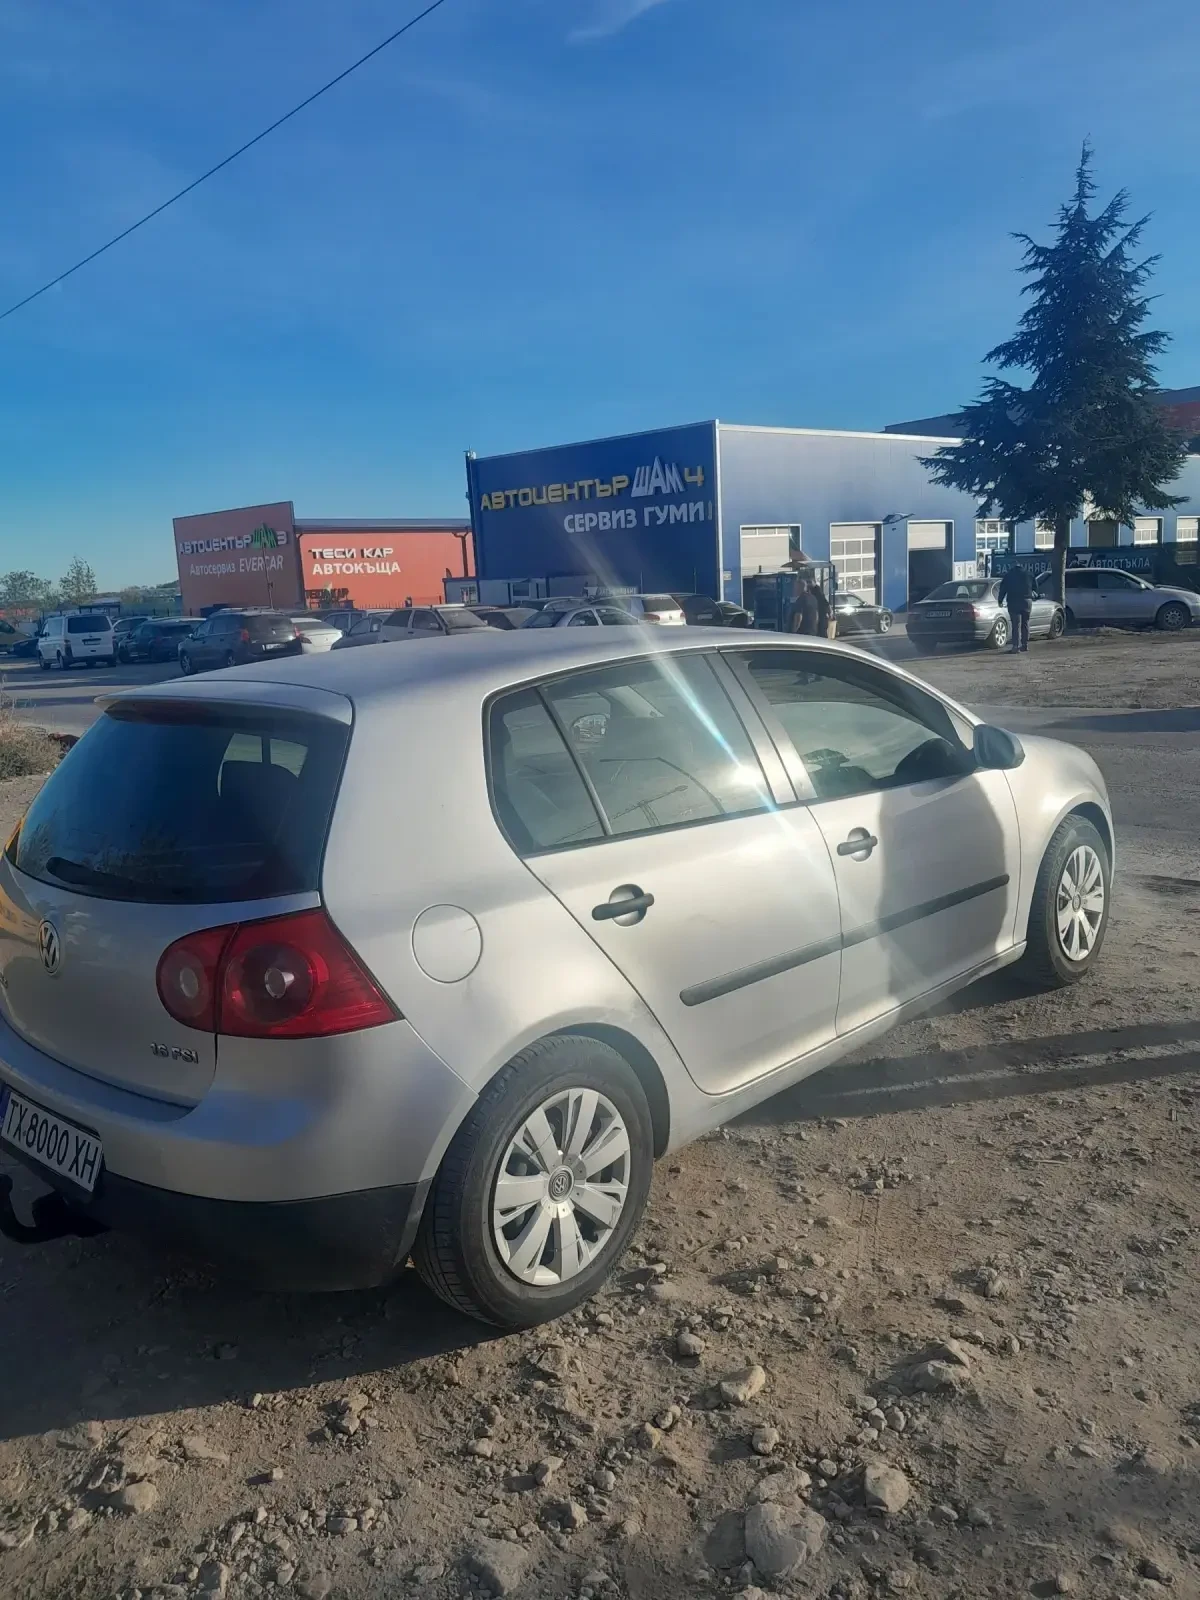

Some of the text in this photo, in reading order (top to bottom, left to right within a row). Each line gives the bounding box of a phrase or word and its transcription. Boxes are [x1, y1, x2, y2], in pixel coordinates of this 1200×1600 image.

[480, 455, 705, 510] АВТОЦЕНТЪР ШАМ 4
[563, 508, 637, 533] СЕРВИЗ
[178, 534, 252, 555] АВТОЦЕНТЪР
[311, 547, 394, 560] ТЕСИ КАР
[189, 554, 284, 578] Автосервиз EVERCAR
[312, 561, 401, 576] АВТОКЪЩА
[1089, 557, 1151, 570] АВТОСТЪКЛА
[171, 1045, 199, 1064] FSI
